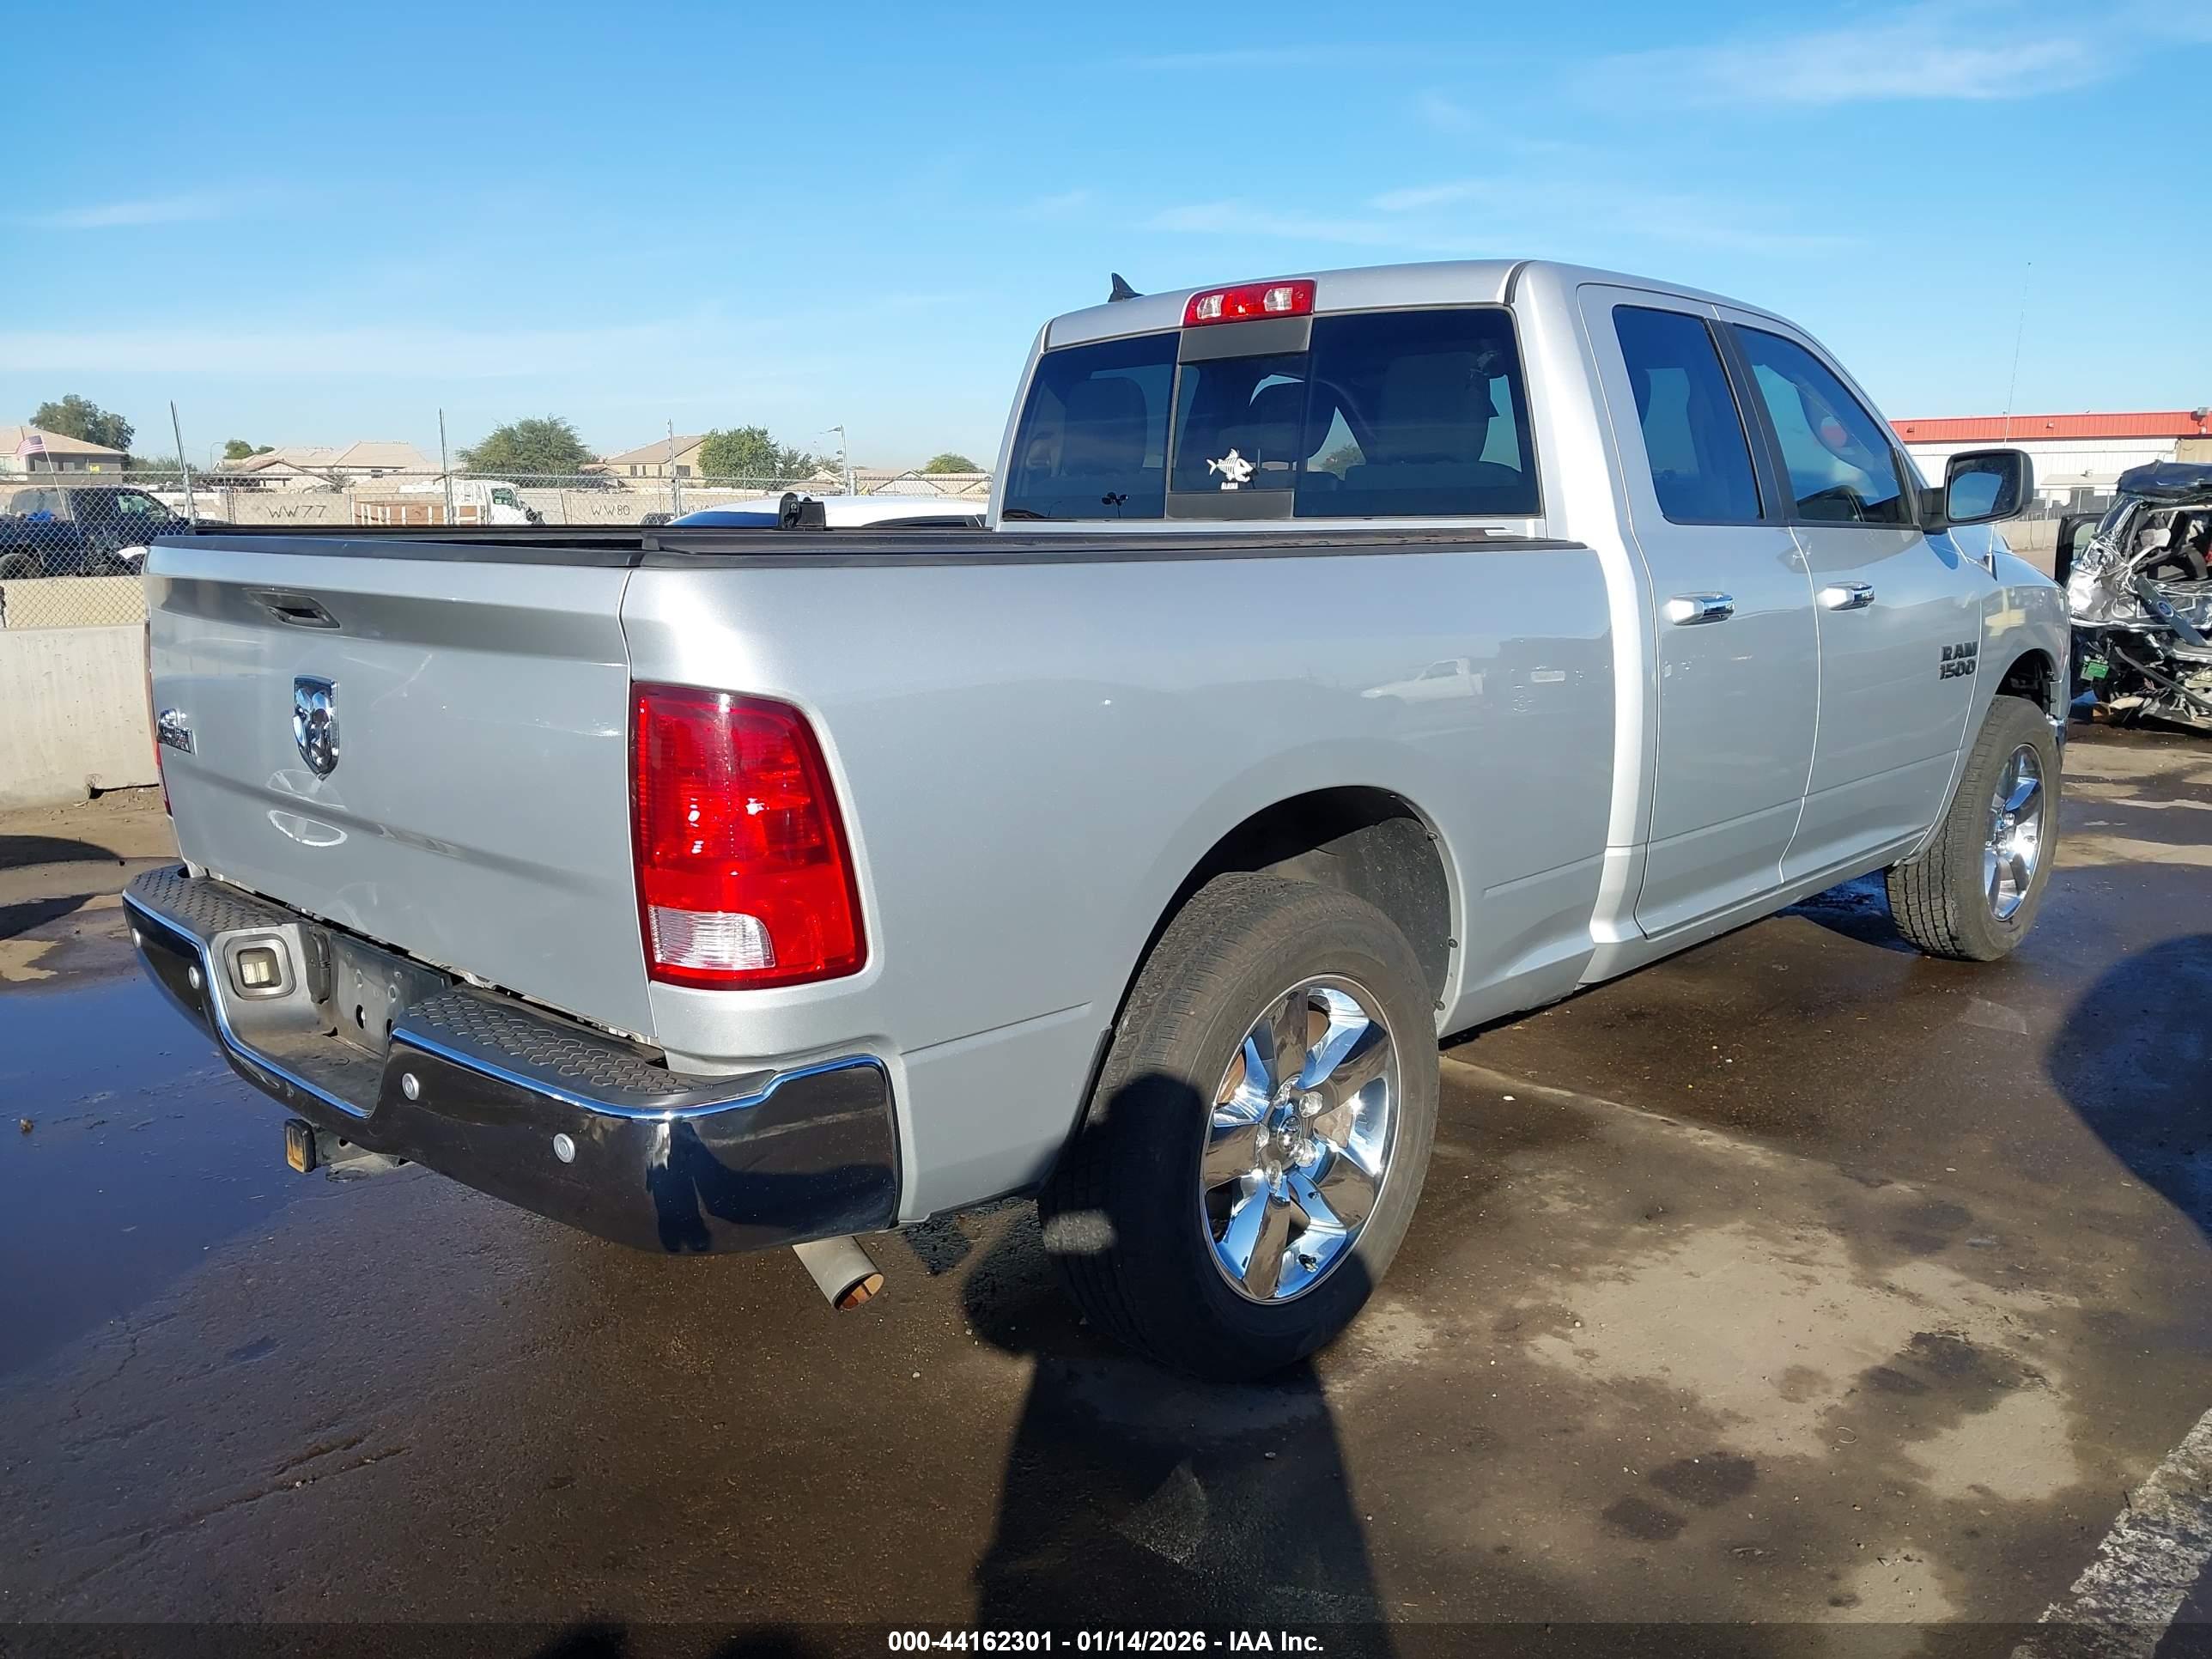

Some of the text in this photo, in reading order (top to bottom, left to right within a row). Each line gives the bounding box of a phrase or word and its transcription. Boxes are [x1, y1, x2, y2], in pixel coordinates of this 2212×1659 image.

[266, 505, 326, 519] WW77
[591, 505, 630, 516] WW80
[1940, 641, 1978, 662] RAM
[1939, 659, 1976, 680] 1500
